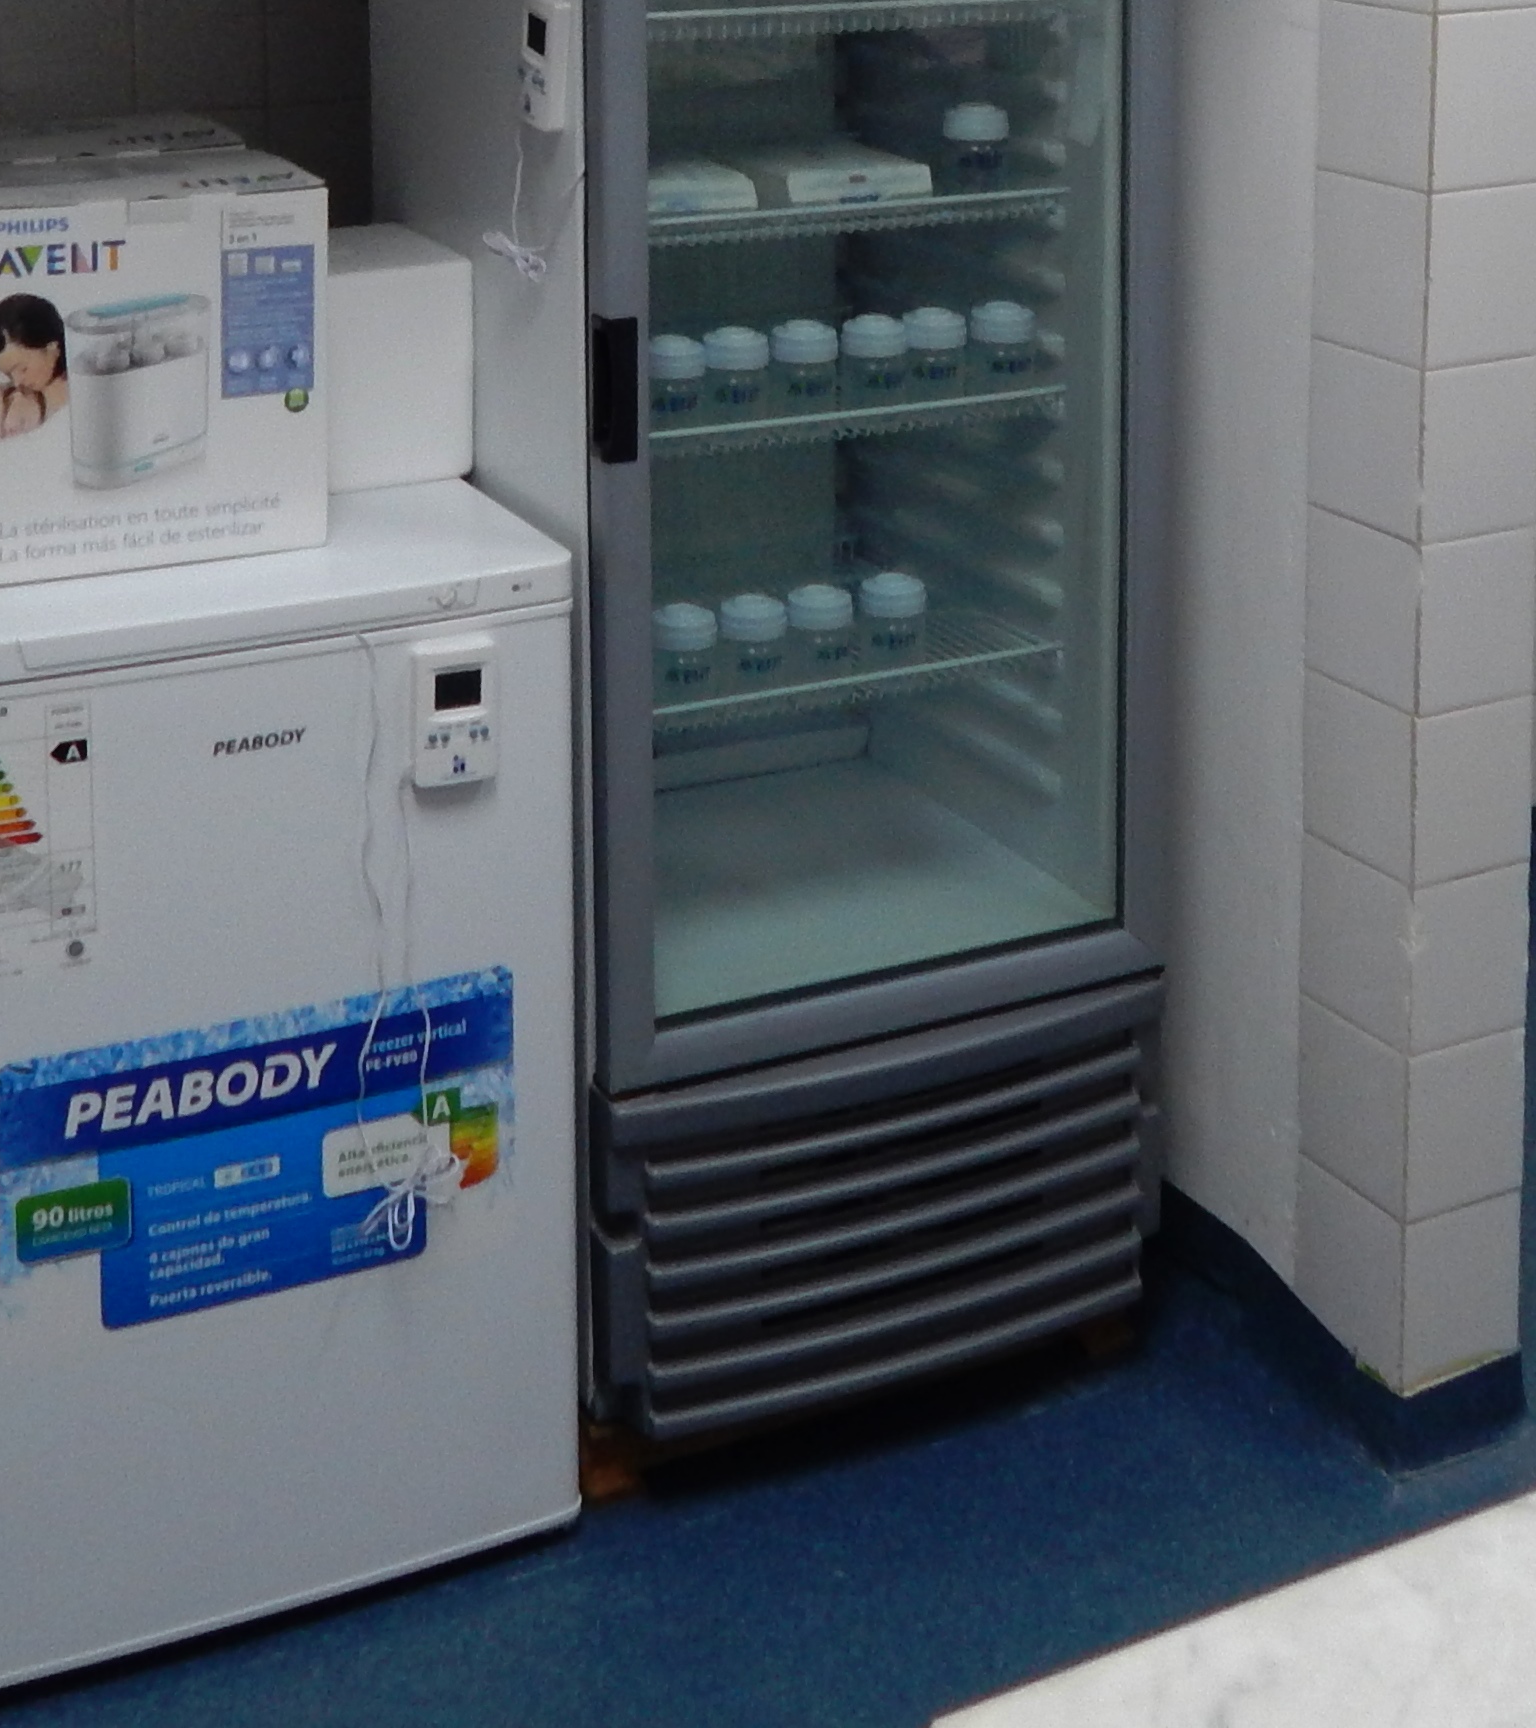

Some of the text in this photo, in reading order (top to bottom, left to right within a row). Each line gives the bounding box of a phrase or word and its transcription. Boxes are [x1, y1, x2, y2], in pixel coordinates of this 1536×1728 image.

[127, 512, 149, 525] en
[154, 502, 199, 522] toute
[25, 539, 77, 560] forma
[159, 525, 182, 545] de
[65, 744, 82, 761] A
[213, 726, 306, 757] PEABODY
[417, 1017, 467, 1044] vrtical
[65, 1042, 337, 1140] PEABODY
[431, 1094, 452, 1120] A
[32, 1201, 114, 1232] 90 litros
[148, 1213, 201, 1237] Control
[204, 1210, 221, 1225] de
[149, 1286, 197, 1308] Puerta
